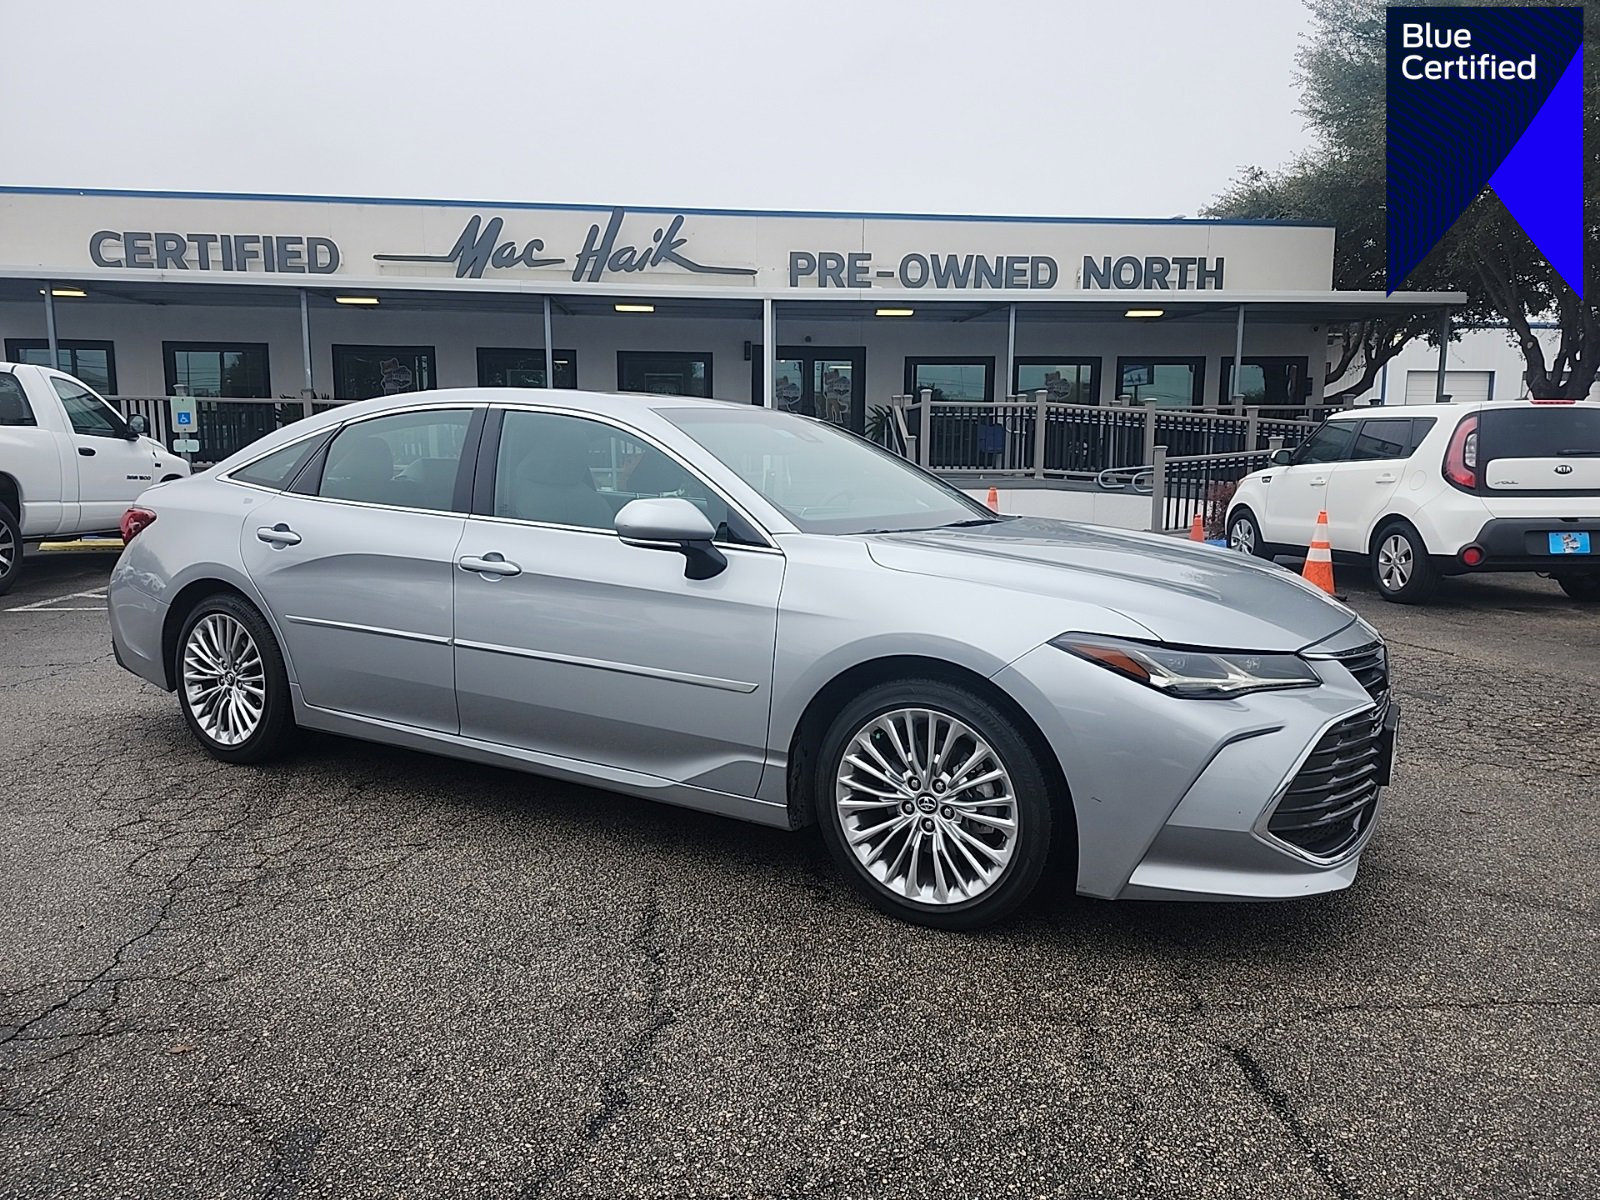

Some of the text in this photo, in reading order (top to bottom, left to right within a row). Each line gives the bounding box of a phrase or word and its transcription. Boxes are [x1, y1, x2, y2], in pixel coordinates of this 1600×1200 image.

[89, 230, 340, 274] CERTIFIED
[373, 207, 758, 283] Mac Haik
[789, 251, 1225, 290] PRE-OWNED NORTH
